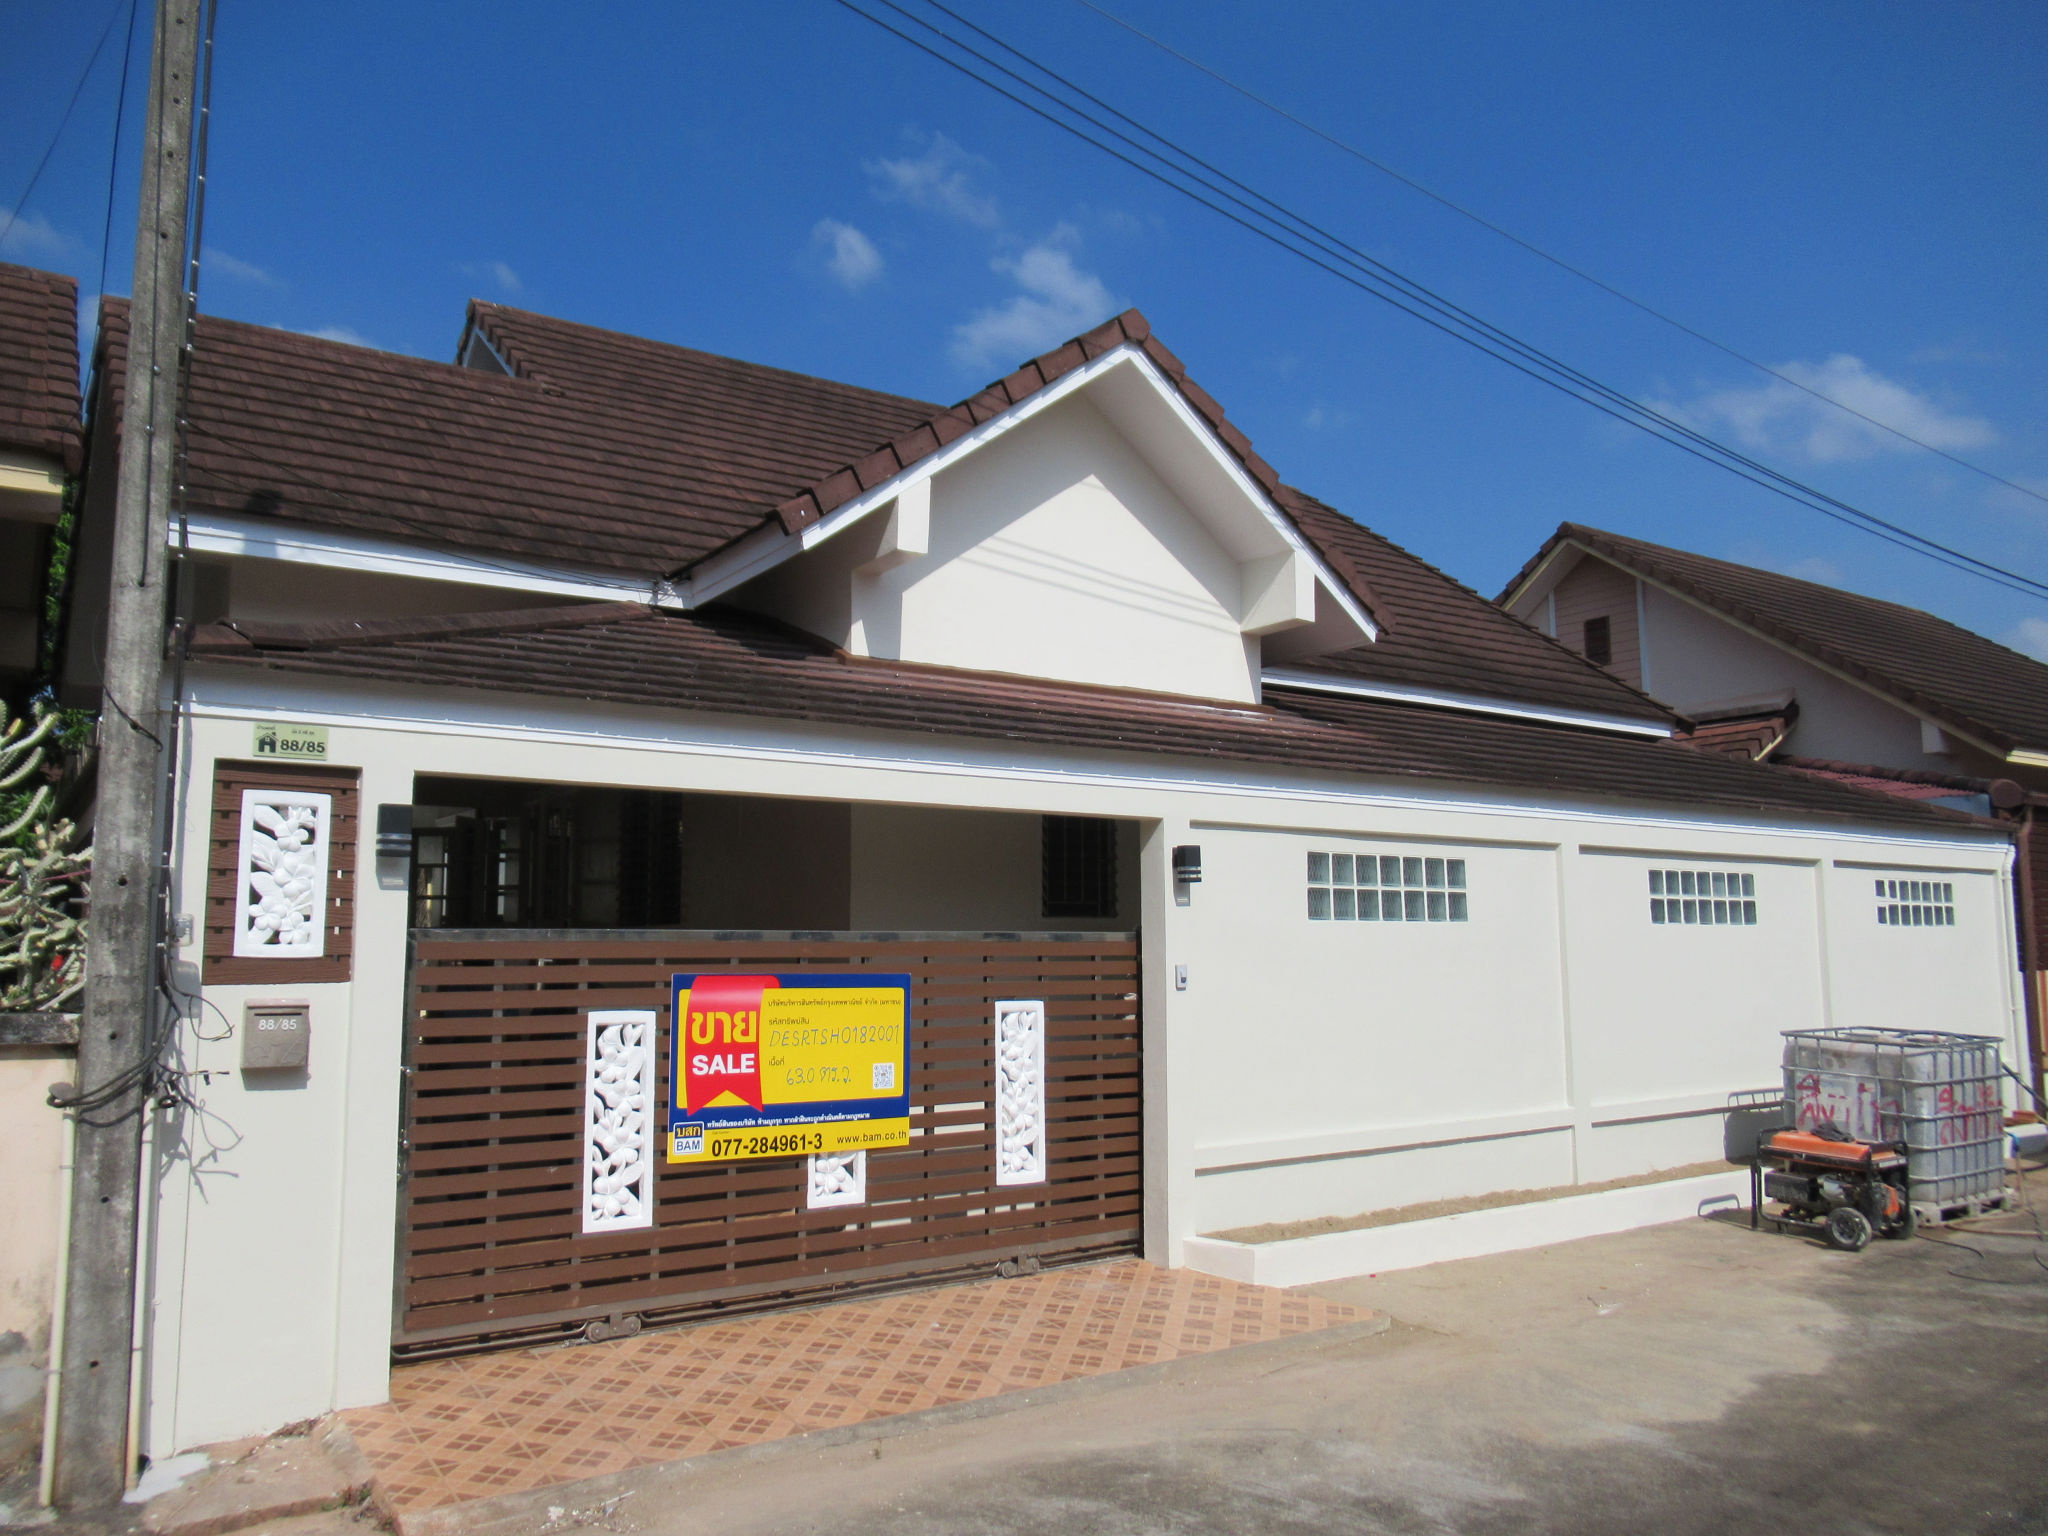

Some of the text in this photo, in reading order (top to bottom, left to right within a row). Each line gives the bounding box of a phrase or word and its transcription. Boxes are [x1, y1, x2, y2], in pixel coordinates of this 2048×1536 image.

[280, 738, 326, 753] 88/85
[258, 1018, 297, 1031] 88/85
[691, 1010, 757, 1044] ขาย
[692, 1053, 755, 1076] SALE
[768, 1055, 785, 1067] เนื้อที่
[786, 1066, 815, 1086] 63.0
[676, 1125, 701, 1137] บสก
[676, 1140, 700, 1151] BAM
[711, 1129, 907, 1157] 077-284961-3 www.bam.co.th
